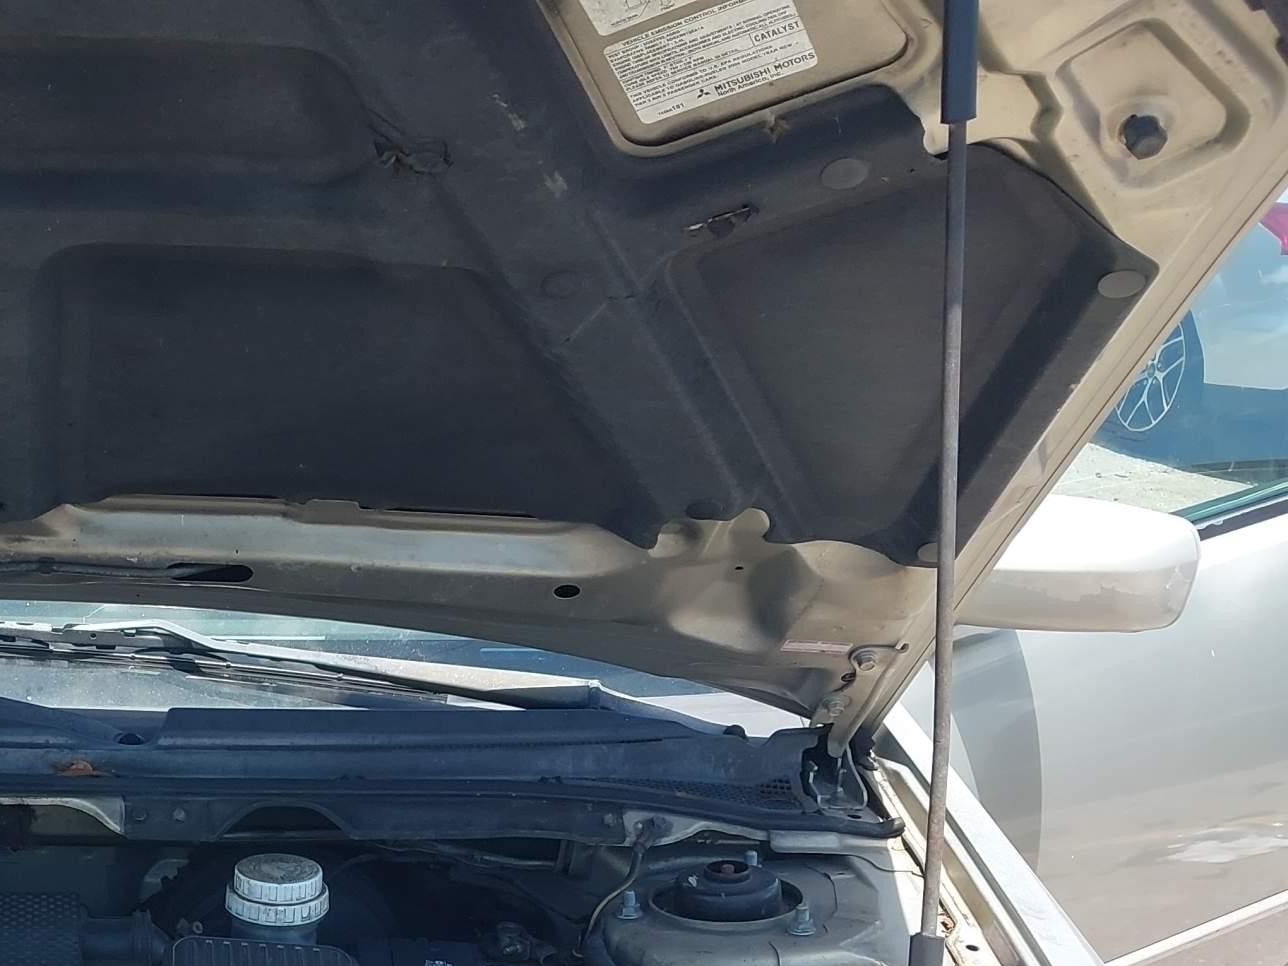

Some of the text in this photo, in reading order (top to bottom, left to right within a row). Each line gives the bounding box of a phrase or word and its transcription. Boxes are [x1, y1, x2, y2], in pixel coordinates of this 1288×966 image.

[754, 21, 800, 42] CATALYST
[714, 67, 771, 92] MITSUBISHI
[773, 52, 816, 72] MOTORS
[718, 87, 736, 97] North
